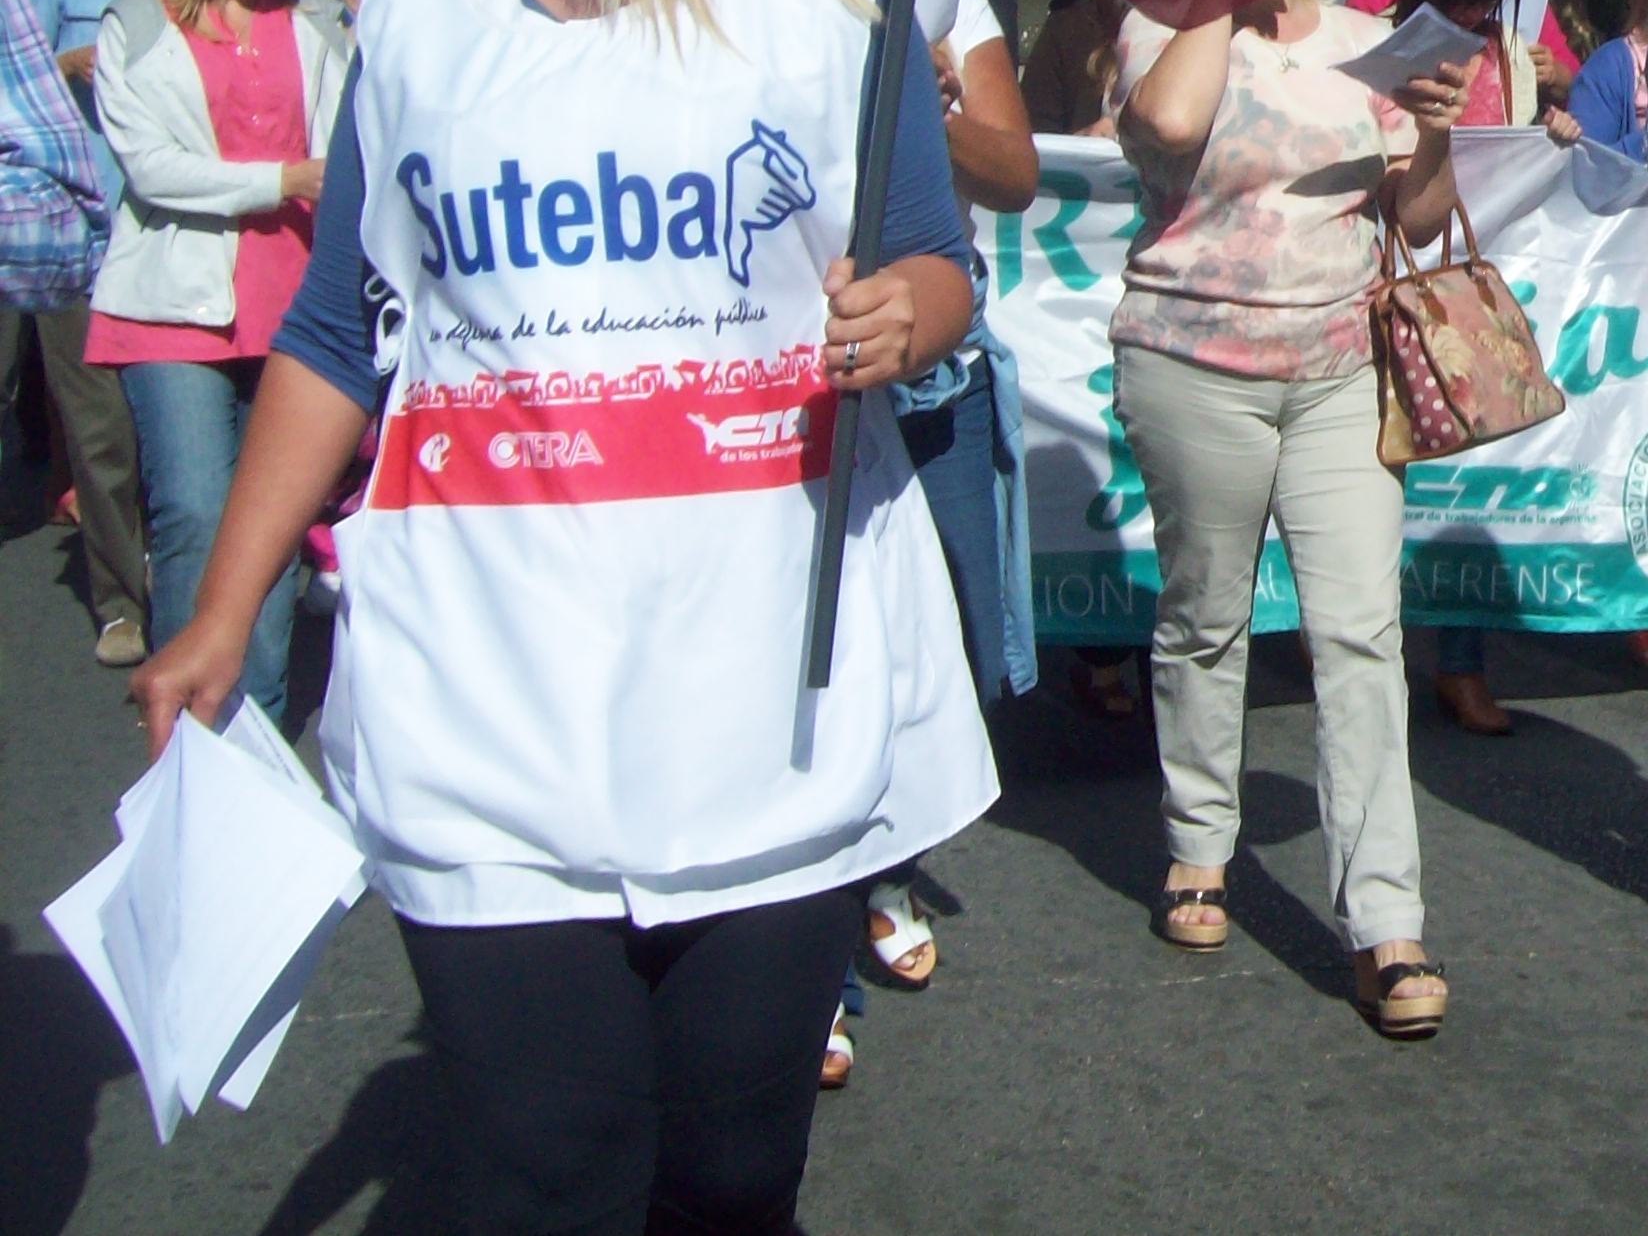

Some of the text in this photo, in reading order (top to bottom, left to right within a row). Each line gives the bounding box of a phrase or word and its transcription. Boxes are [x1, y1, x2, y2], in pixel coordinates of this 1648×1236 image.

[396, 150, 718, 280] Suteba
[511, 313, 537, 341] de
[545, 309, 571, 336] la
[581, 306, 705, 334] educación
[488, 429, 604, 469] CTERA
[720, 450, 737, 463] de
[738, 449, 758, 462] los
[1519, 513, 1533, 524] de
[1043, 572, 1134, 618] ION
